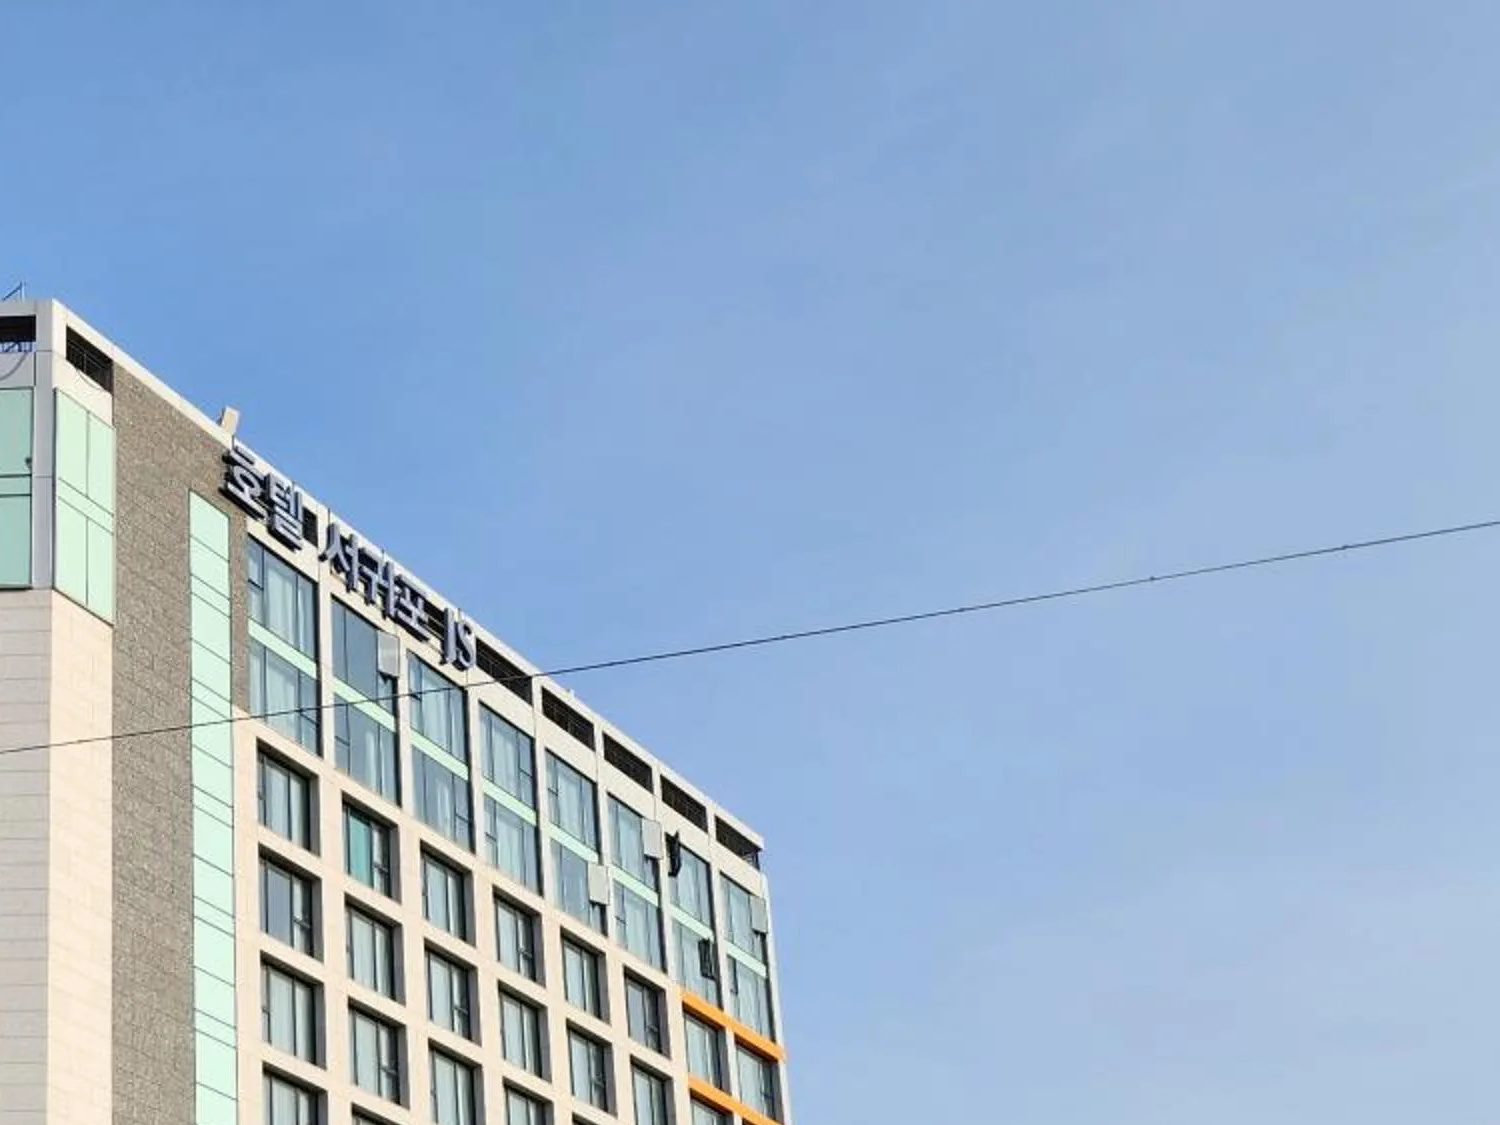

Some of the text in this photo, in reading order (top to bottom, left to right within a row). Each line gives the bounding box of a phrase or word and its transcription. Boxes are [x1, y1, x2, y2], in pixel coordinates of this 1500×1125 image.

[221, 445, 477, 671] 호텔 서귀포 JS
